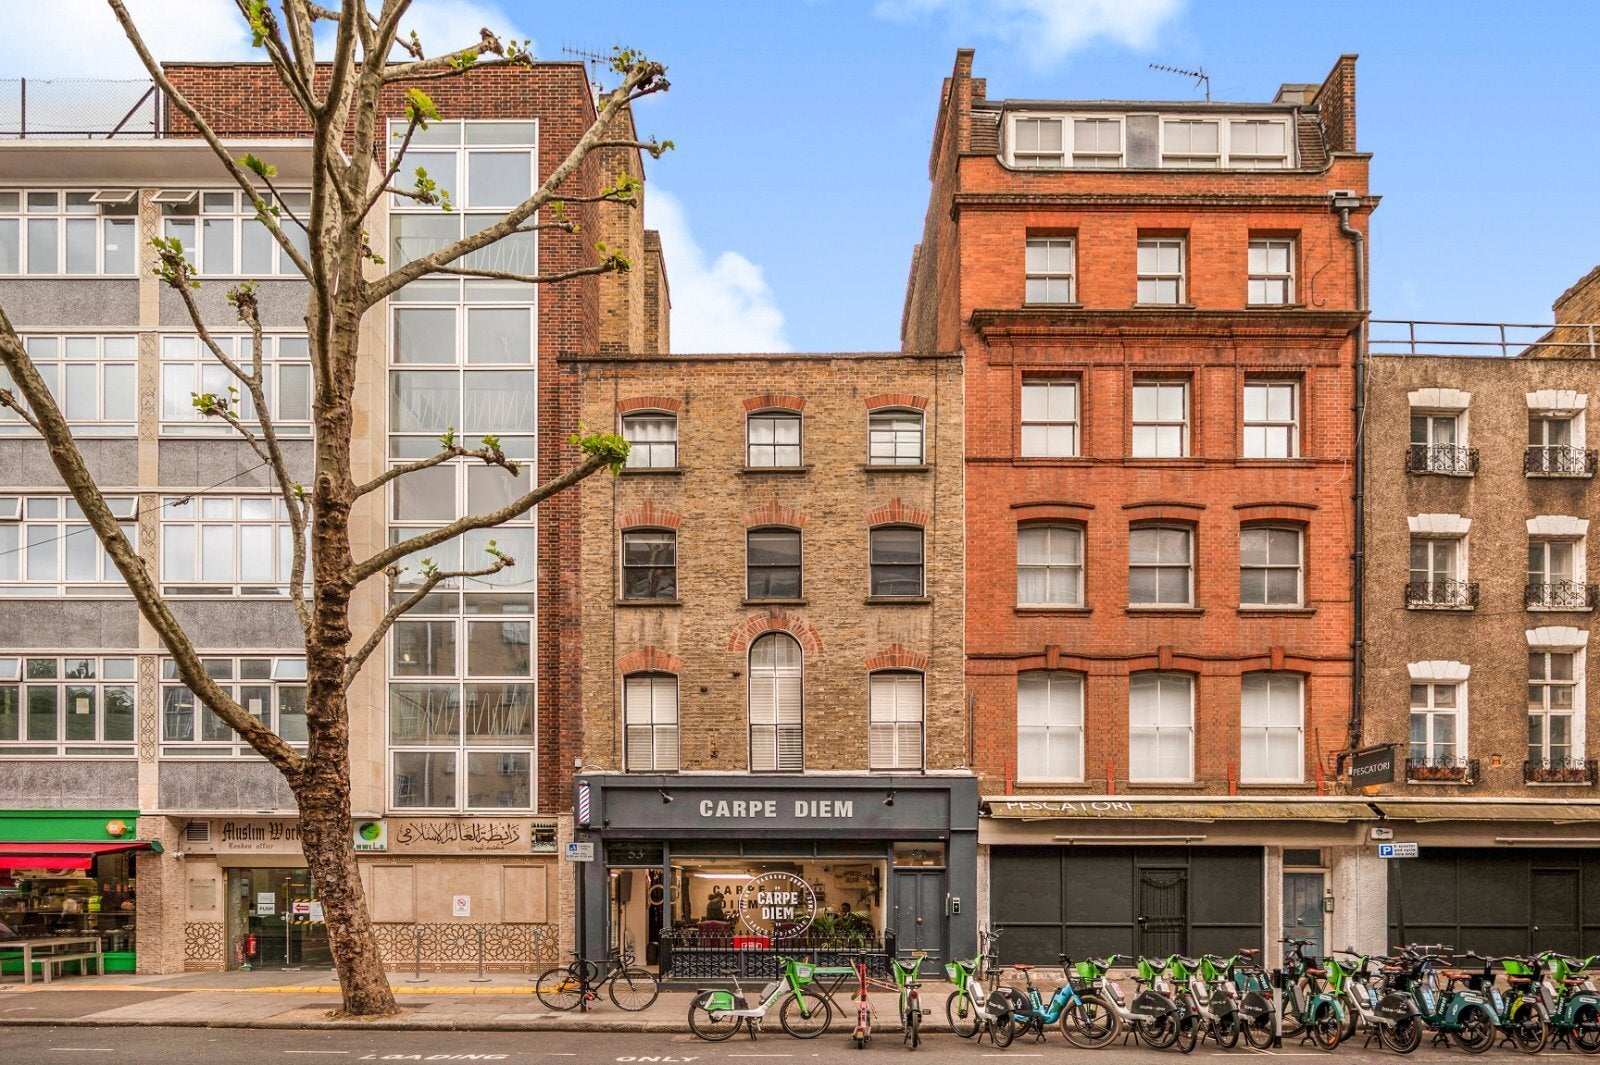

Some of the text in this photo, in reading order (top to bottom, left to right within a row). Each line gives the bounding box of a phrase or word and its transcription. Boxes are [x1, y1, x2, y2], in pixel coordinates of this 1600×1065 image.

[1353, 762, 1390, 776] PESCATORI
[699, 800, 853, 817] CARPE DIEM
[222, 822, 265, 842] Muslim
[1382, 847, 1392, 855] P
[713, 885, 766, 895] CARPE
[757, 891, 798, 905] CARPE
[762, 907, 795, 920] DIEM
